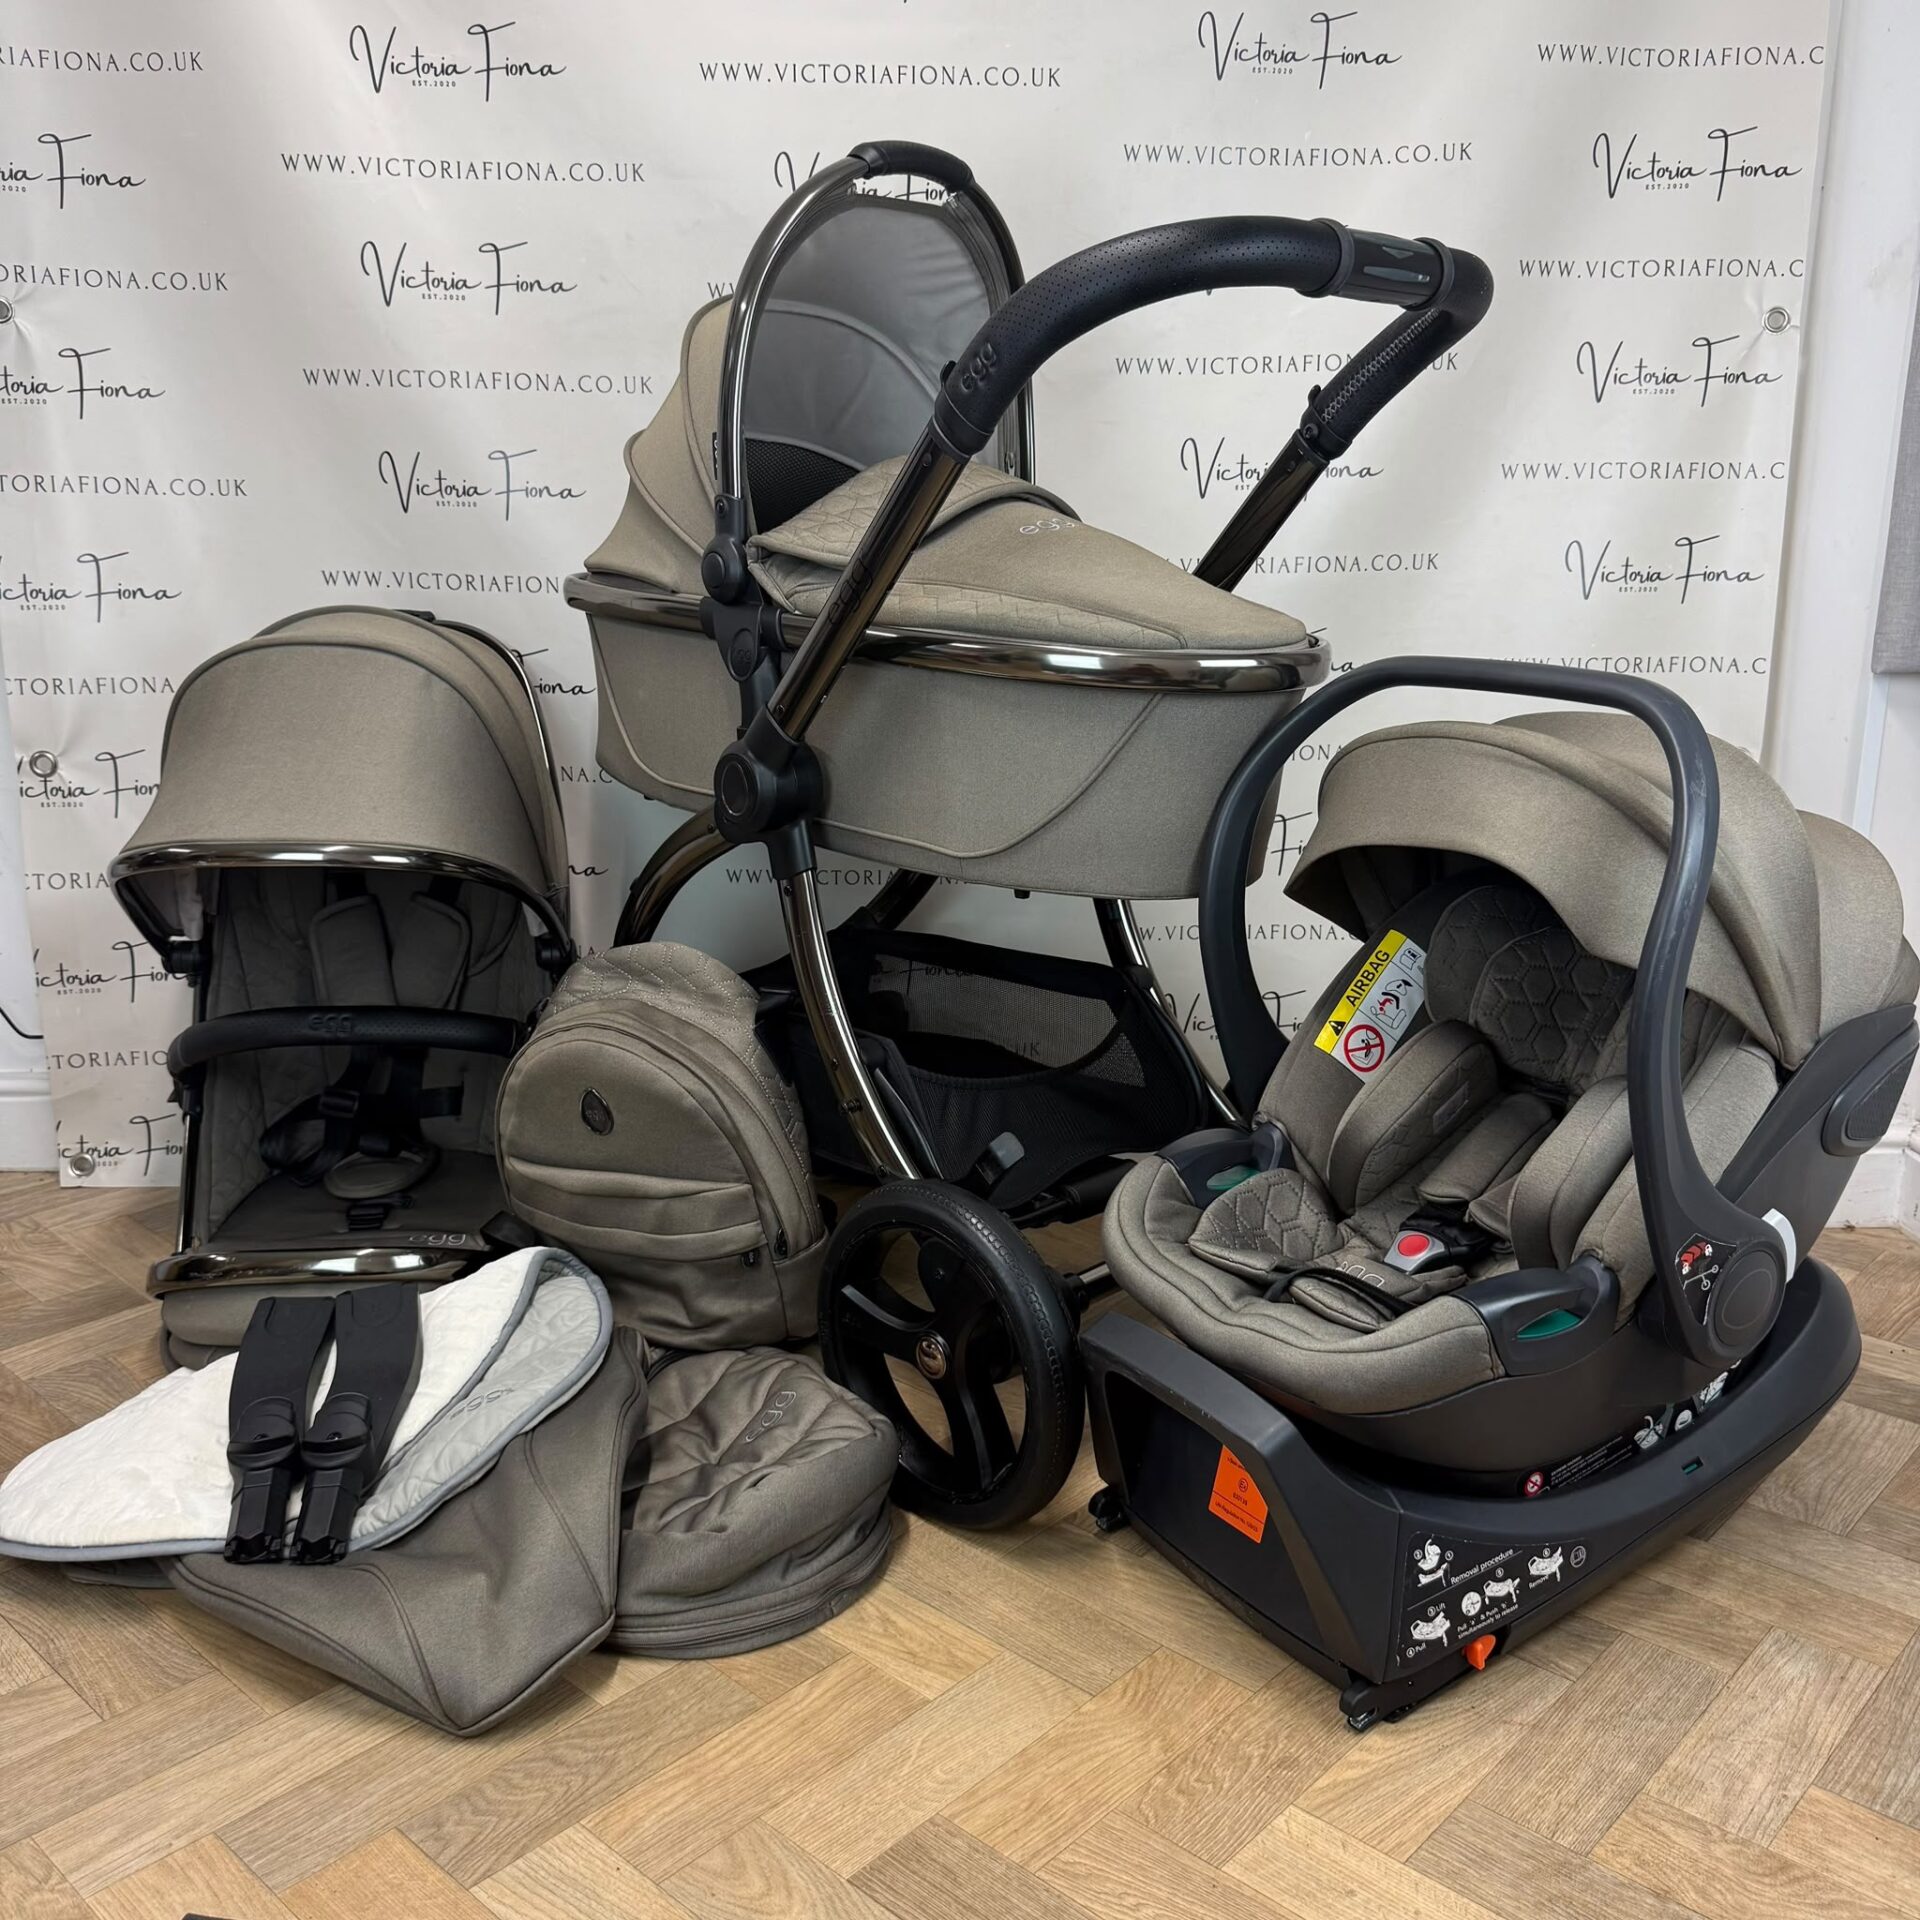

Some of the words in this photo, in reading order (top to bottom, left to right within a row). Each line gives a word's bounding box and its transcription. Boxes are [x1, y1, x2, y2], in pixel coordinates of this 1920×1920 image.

[350, 24, 472, 93] Victoria
[468, 22, 567, 101] Fiona
[1197, 11, 1309, 81] Victoria
[1309, 11, 1401, 89] Fiona
[1537, 43, 1825, 69] WWW.VICTORIAFIONA.C
[411, 79, 457, 88] EST.2020
[699, 62, 1060, 87] WWW.VICTORIAFIONA.CO.UK
[1251, 66, 1294, 75] EST.2020
[37, 133, 146, 209] Fiona
[281, 153, 645, 182] WWW.VICTORIAFIONA.CO.UK
[1124, 142, 1472, 166] WWW.VICTORIAFIONA.CO.UK
[1592, 132, 1707, 198] Victoria
[1706, 127, 1802, 201] Fiona
[361, 241, 482, 306] Victoria
[478, 242, 576, 315] Fiona
[1518, 256, 1804, 280] WWW.VICTORIAFIONA.C
[421, 292, 467, 301] EST.2020
[302, 368, 653, 394] WWW.VICTORIAFIONA.CO.UK
[961, 341, 997, 392] egg
[1115, 352, 1459, 375] WWW.VICTORIAFIOUK
[1576, 341, 1691, 403] Victoria
[1691, 335, 1783, 406] Fiona
[58, 348, 166, 420] Fiona
[379, 451, 491, 513] Victoria
[488, 449, 587, 520] Fiona
[1180, 437, 1269, 500] Victor
[1500, 460, 1785, 482] WWW.VICTORIAFIONA.C
[0, 556, 82, 602] ictoria
[77, 552, 182, 623] Fiona
[1564, 539, 1673, 600] Victoria
[1673, 535, 1765, 604] Fiona
[17, 756, 100, 800] ictoria
[95, 749, 160, 818] Fion
[24, 871, 110, 891] TORIA
[33, 948, 117, 988] ictoria
[1345, 949, 1390, 1008] AIRBAG
[308, 1011, 354, 1036] egg
[56, 1120, 134, 1160] ictoria
[408, 1232, 467, 1247] egg
[1450, 1564, 1479, 1585] Removal
[1480, 1549, 1514, 1572] procedure
[1435, 1602, 1446, 1612] Lift
[1415, 1642, 1427, 1653] Pull
